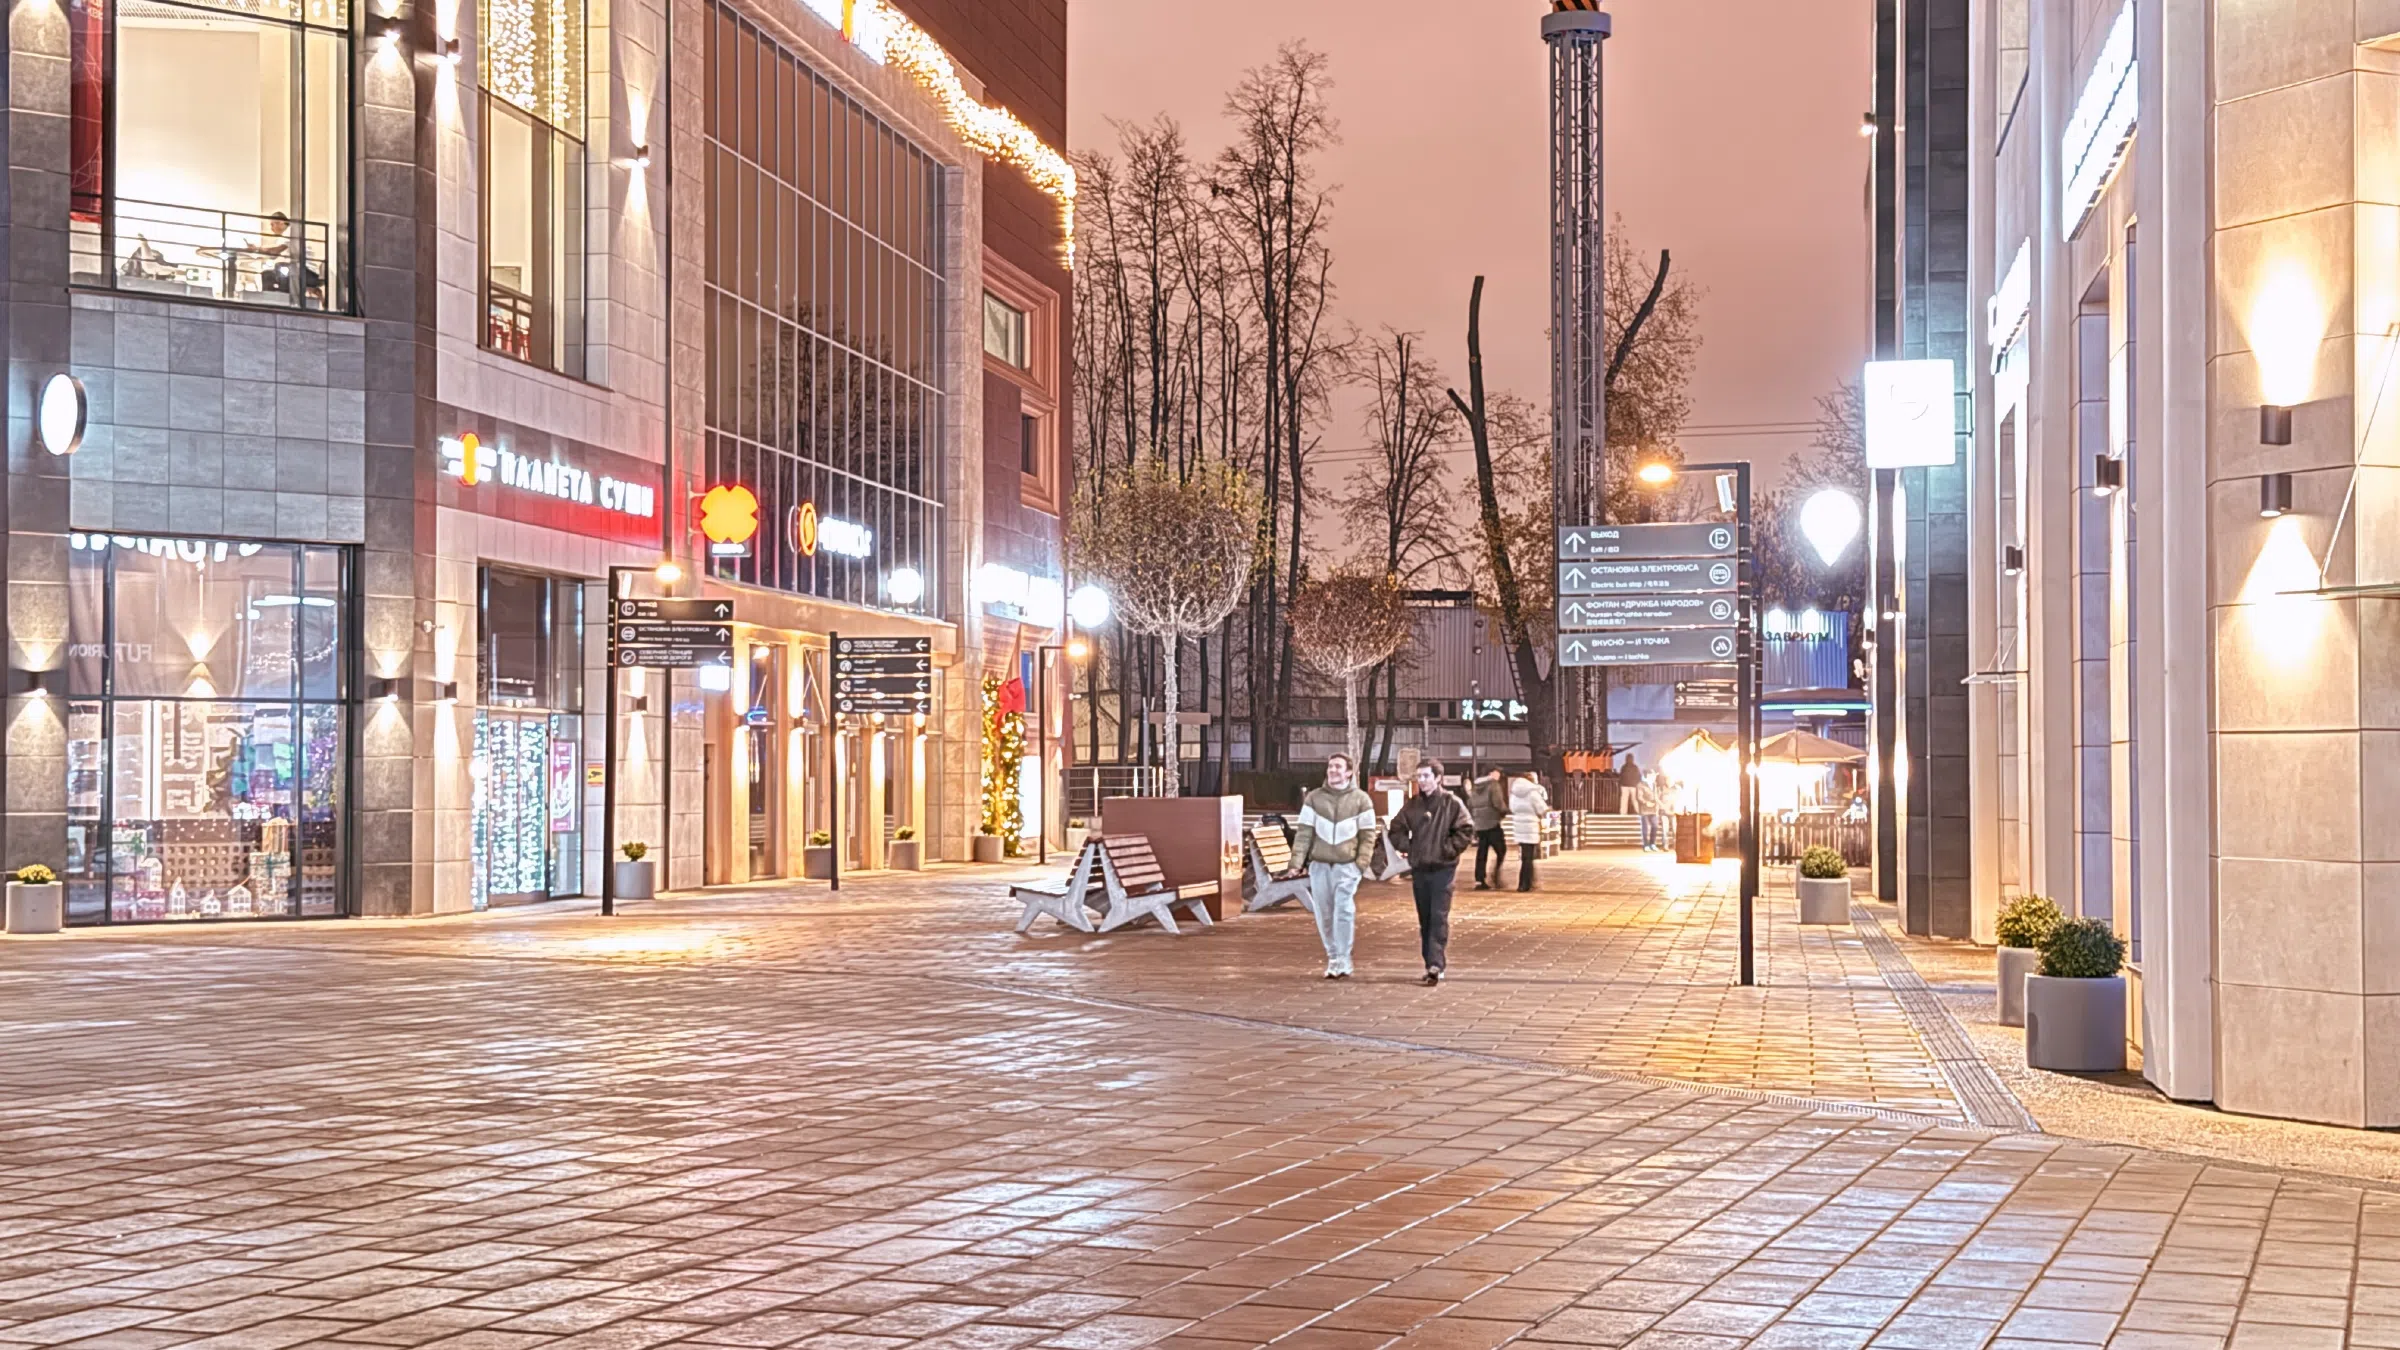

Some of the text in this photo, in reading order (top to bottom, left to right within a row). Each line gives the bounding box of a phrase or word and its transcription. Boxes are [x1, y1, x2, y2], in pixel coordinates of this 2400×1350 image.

[500, 450, 654, 517] ПЛАНЕТА СУШИ
[1591, 531, 1619, 539] ВЫХОД
[1591, 564, 1699, 574] ОСТАНОВКА ЭЛЕКТРОБУСА
[1586, 601, 1619, 609] ФОНТАН
[1621, 600, 1659, 609] «ДРУЖБА
[1592, 639, 1624, 647] ВКУСНО
[1643, 637, 1670, 645] ТОЧКА
